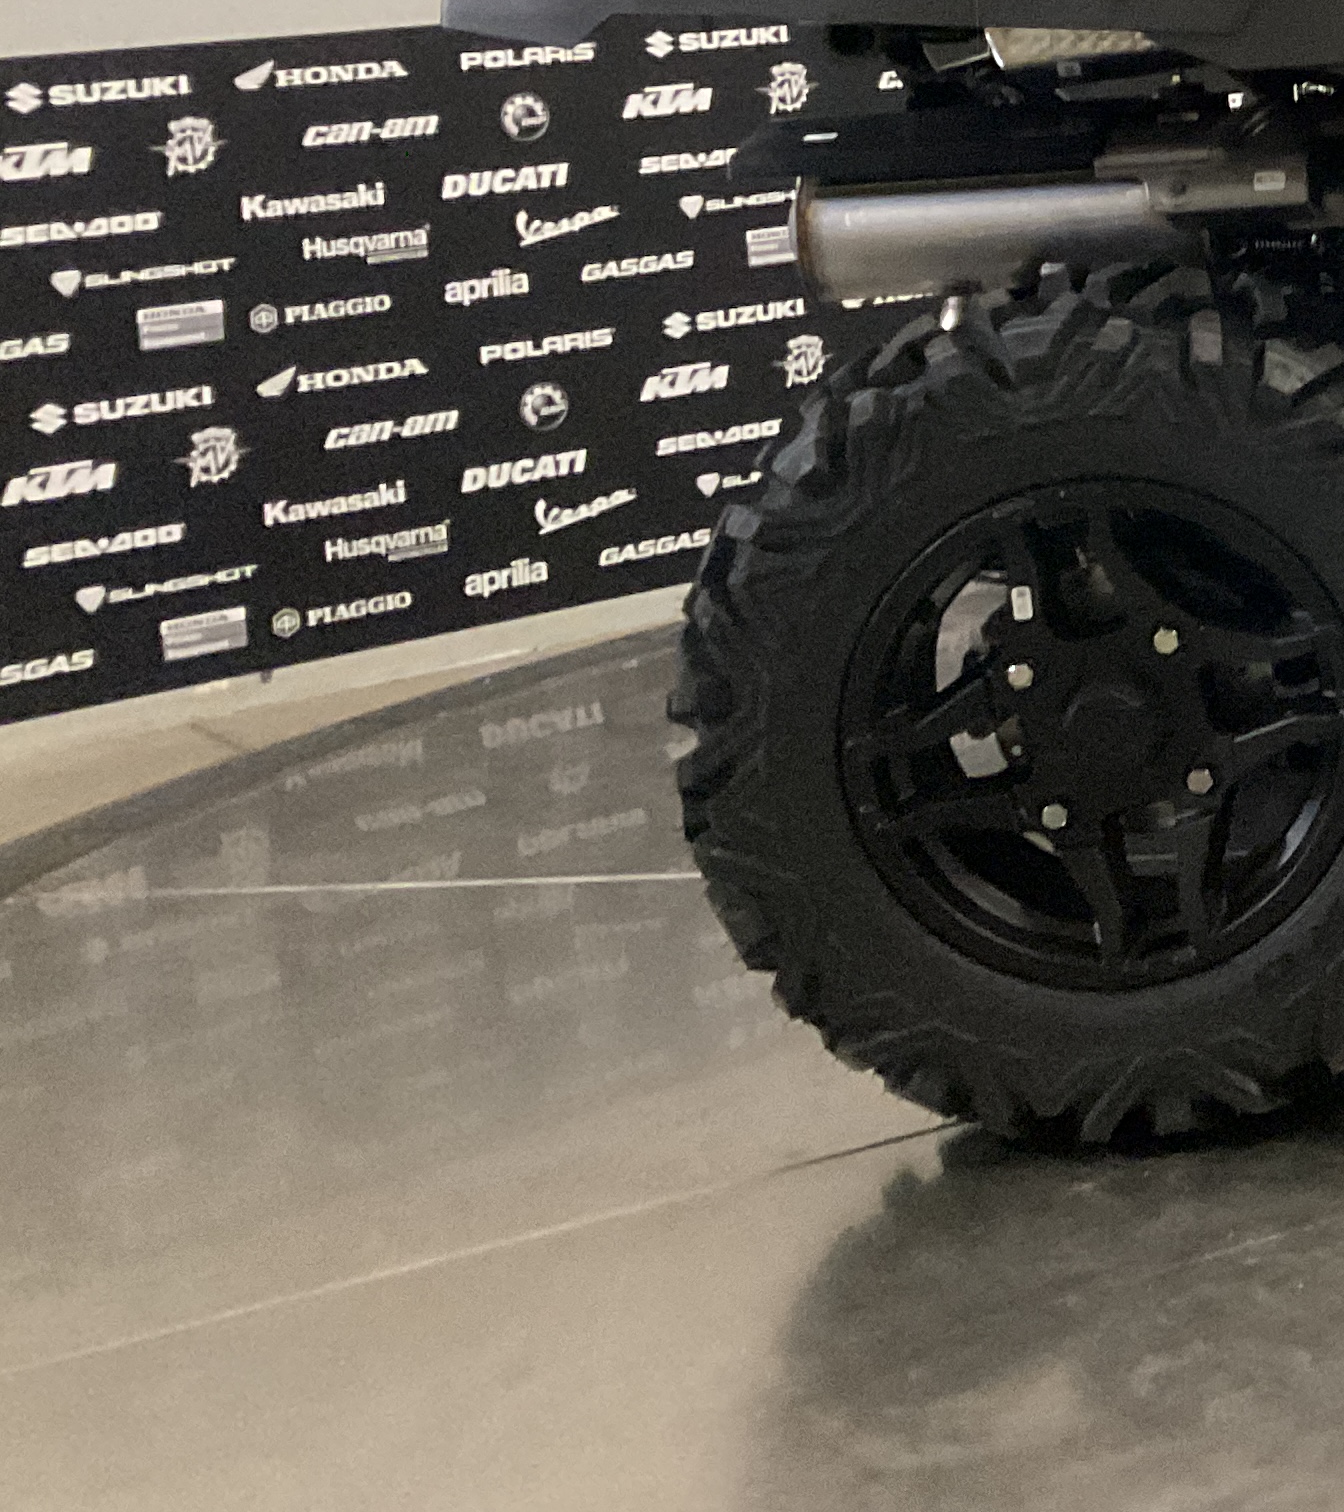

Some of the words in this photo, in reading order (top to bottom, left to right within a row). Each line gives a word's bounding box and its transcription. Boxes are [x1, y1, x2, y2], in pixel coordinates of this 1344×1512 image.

[679, 25, 789, 51] SUZUKI
[275, 60, 409, 87] HONDA
[460, 42, 596, 71] POLARIS
[48, 75, 191, 105] SUZUKI
[622, 83, 712, 119] KTM
[442, 163, 569, 199] DUCATI
[241, 182, 384, 220] Kawasaki
[705, 189, 796, 212] SLINGSH
[302, 226, 428, 261] Husqvarna
[516, 206, 619, 246] Vespa
[581, 251, 694, 282] GASGAS
[445, 269, 529, 306] aprilia
[285, 295, 391, 323] PIAGGIO
[696, 298, 805, 331] SUZUKI
[480, 328, 615, 365] POLARIS
[297, 359, 428, 392] HONDA
[640, 362, 729, 401] KTM
[74, 385, 214, 424] SUZUKI
[0, 460, 116, 506] KTM
[461, 449, 587, 493] DUCATI
[264, 480, 406, 526] Kawasaki
[535, 489, 636, 535] Vespa
[325, 524, 450, 563] Husqvarna
[599, 529, 711, 566] GASGAS
[465, 558, 548, 597] aprilia
[307, 591, 412, 626] PIAGGIO
